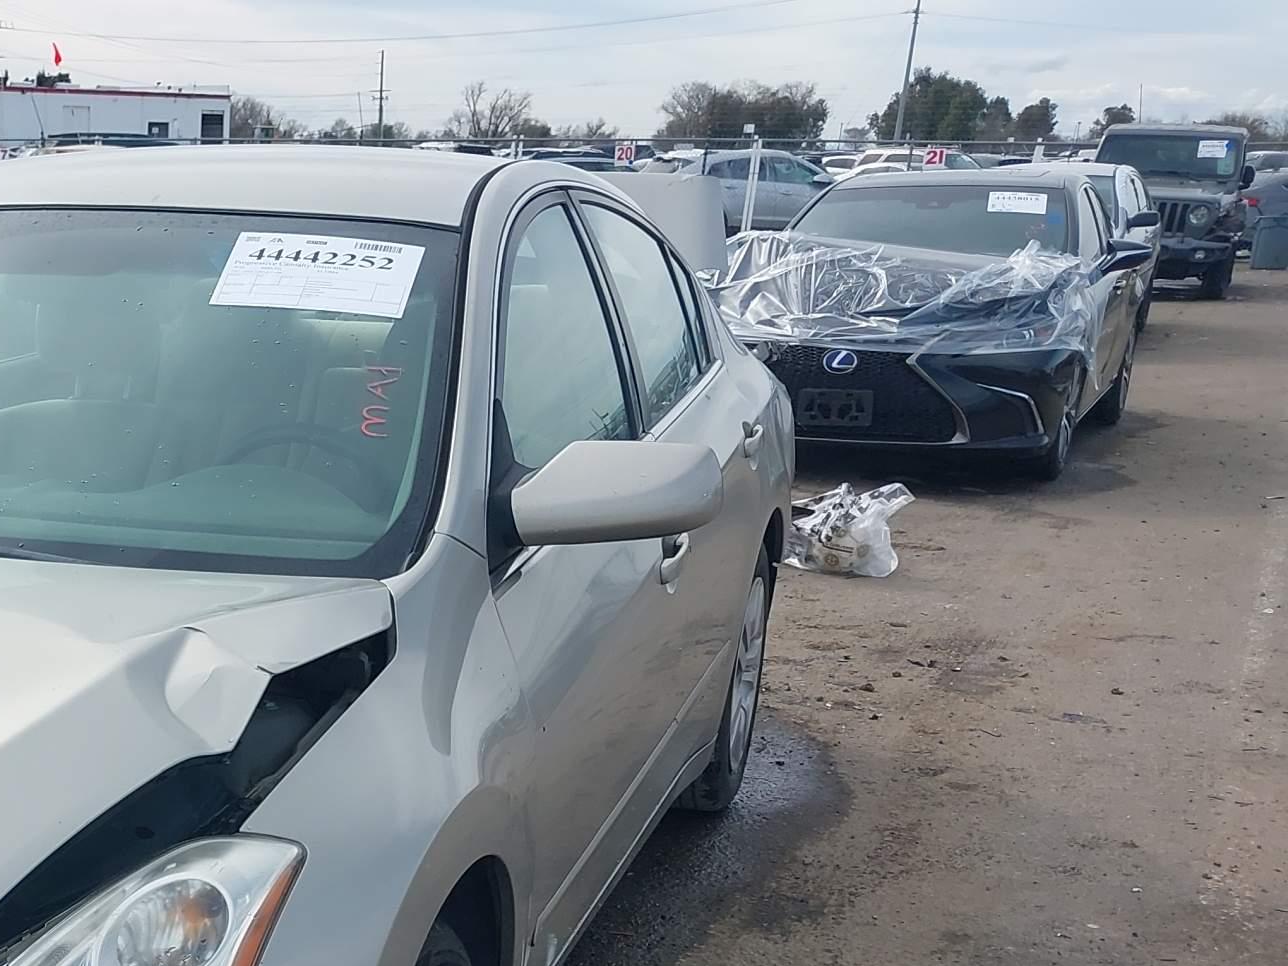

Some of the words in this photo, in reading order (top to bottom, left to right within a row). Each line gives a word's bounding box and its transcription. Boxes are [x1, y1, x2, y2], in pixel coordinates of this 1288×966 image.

[617, 147, 633, 161] 20
[925, 150, 944, 165] 21
[248, 247, 394, 271] 44442252
